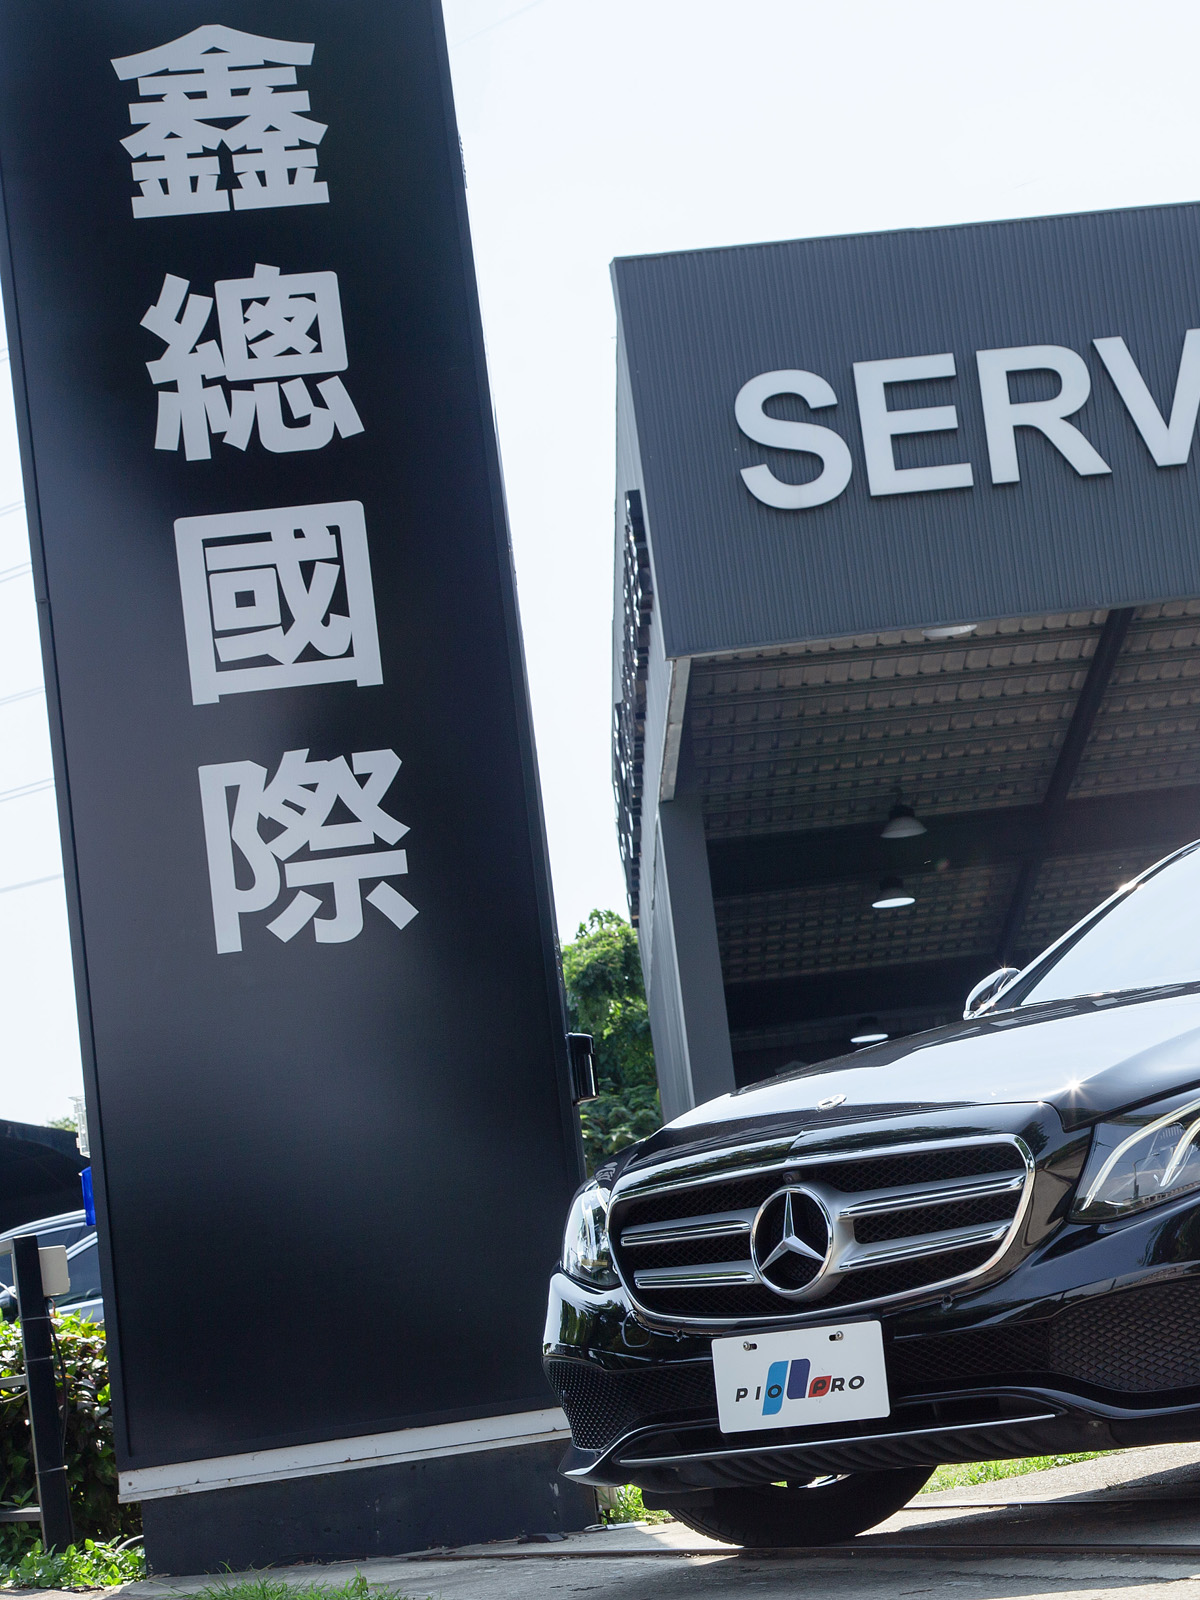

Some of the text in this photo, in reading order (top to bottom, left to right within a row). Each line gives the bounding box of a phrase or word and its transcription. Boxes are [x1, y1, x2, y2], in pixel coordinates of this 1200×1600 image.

[111, 24, 419, 954] 鑫總國際
[735, 1375, 866, 1403] PIO PRO
